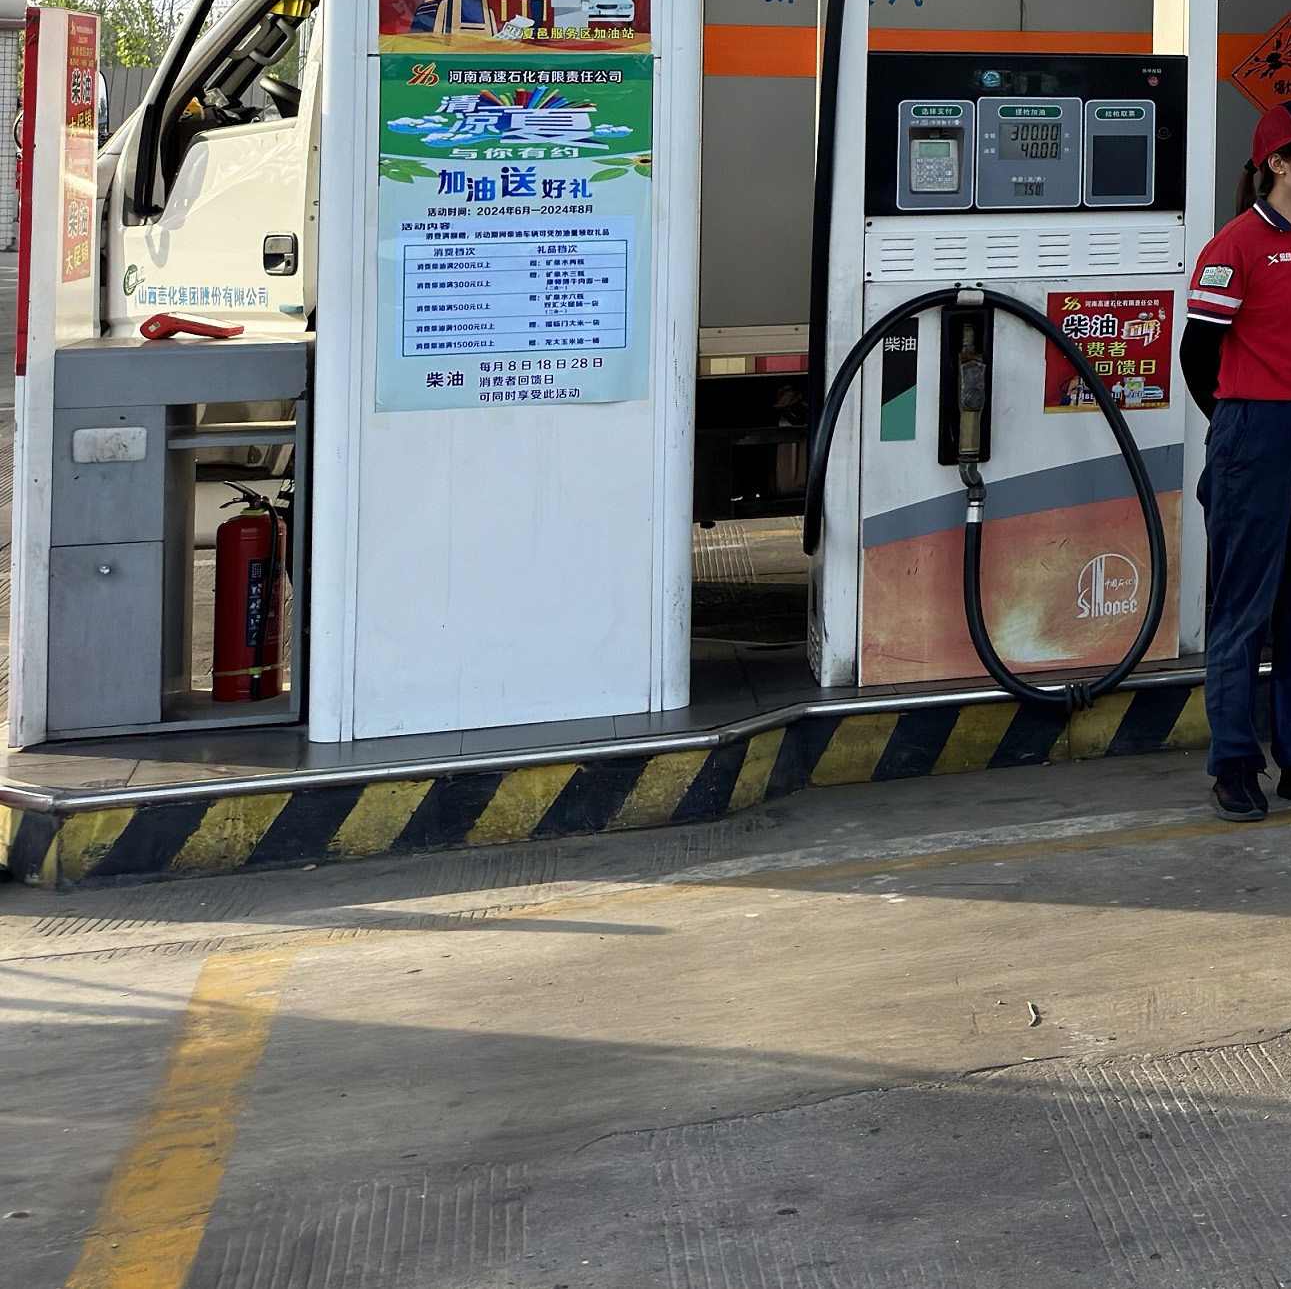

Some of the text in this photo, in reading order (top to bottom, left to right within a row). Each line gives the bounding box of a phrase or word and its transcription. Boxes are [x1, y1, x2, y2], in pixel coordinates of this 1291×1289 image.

[522, 27, 635, 40] 夏邑服务区加油站
[448, 69, 622, 84] 河南高速石化有限责任公司
[71, 68, 92, 105] 柴油
[449, 147, 579, 159] 与你有约
[438, 166, 593, 202] 加油送好礼
[67, 200, 88, 238] 柴油
[1064, 314, 1118, 338] 柴油
[884, 336, 916, 352] 柴油
[1095, 359, 1156, 376] 回馈日
[426, 371, 464, 388] 柴油
[480, 375, 554, 388] 消费者回馈日
[479, 388, 580, 402] 可同时享受此活动
